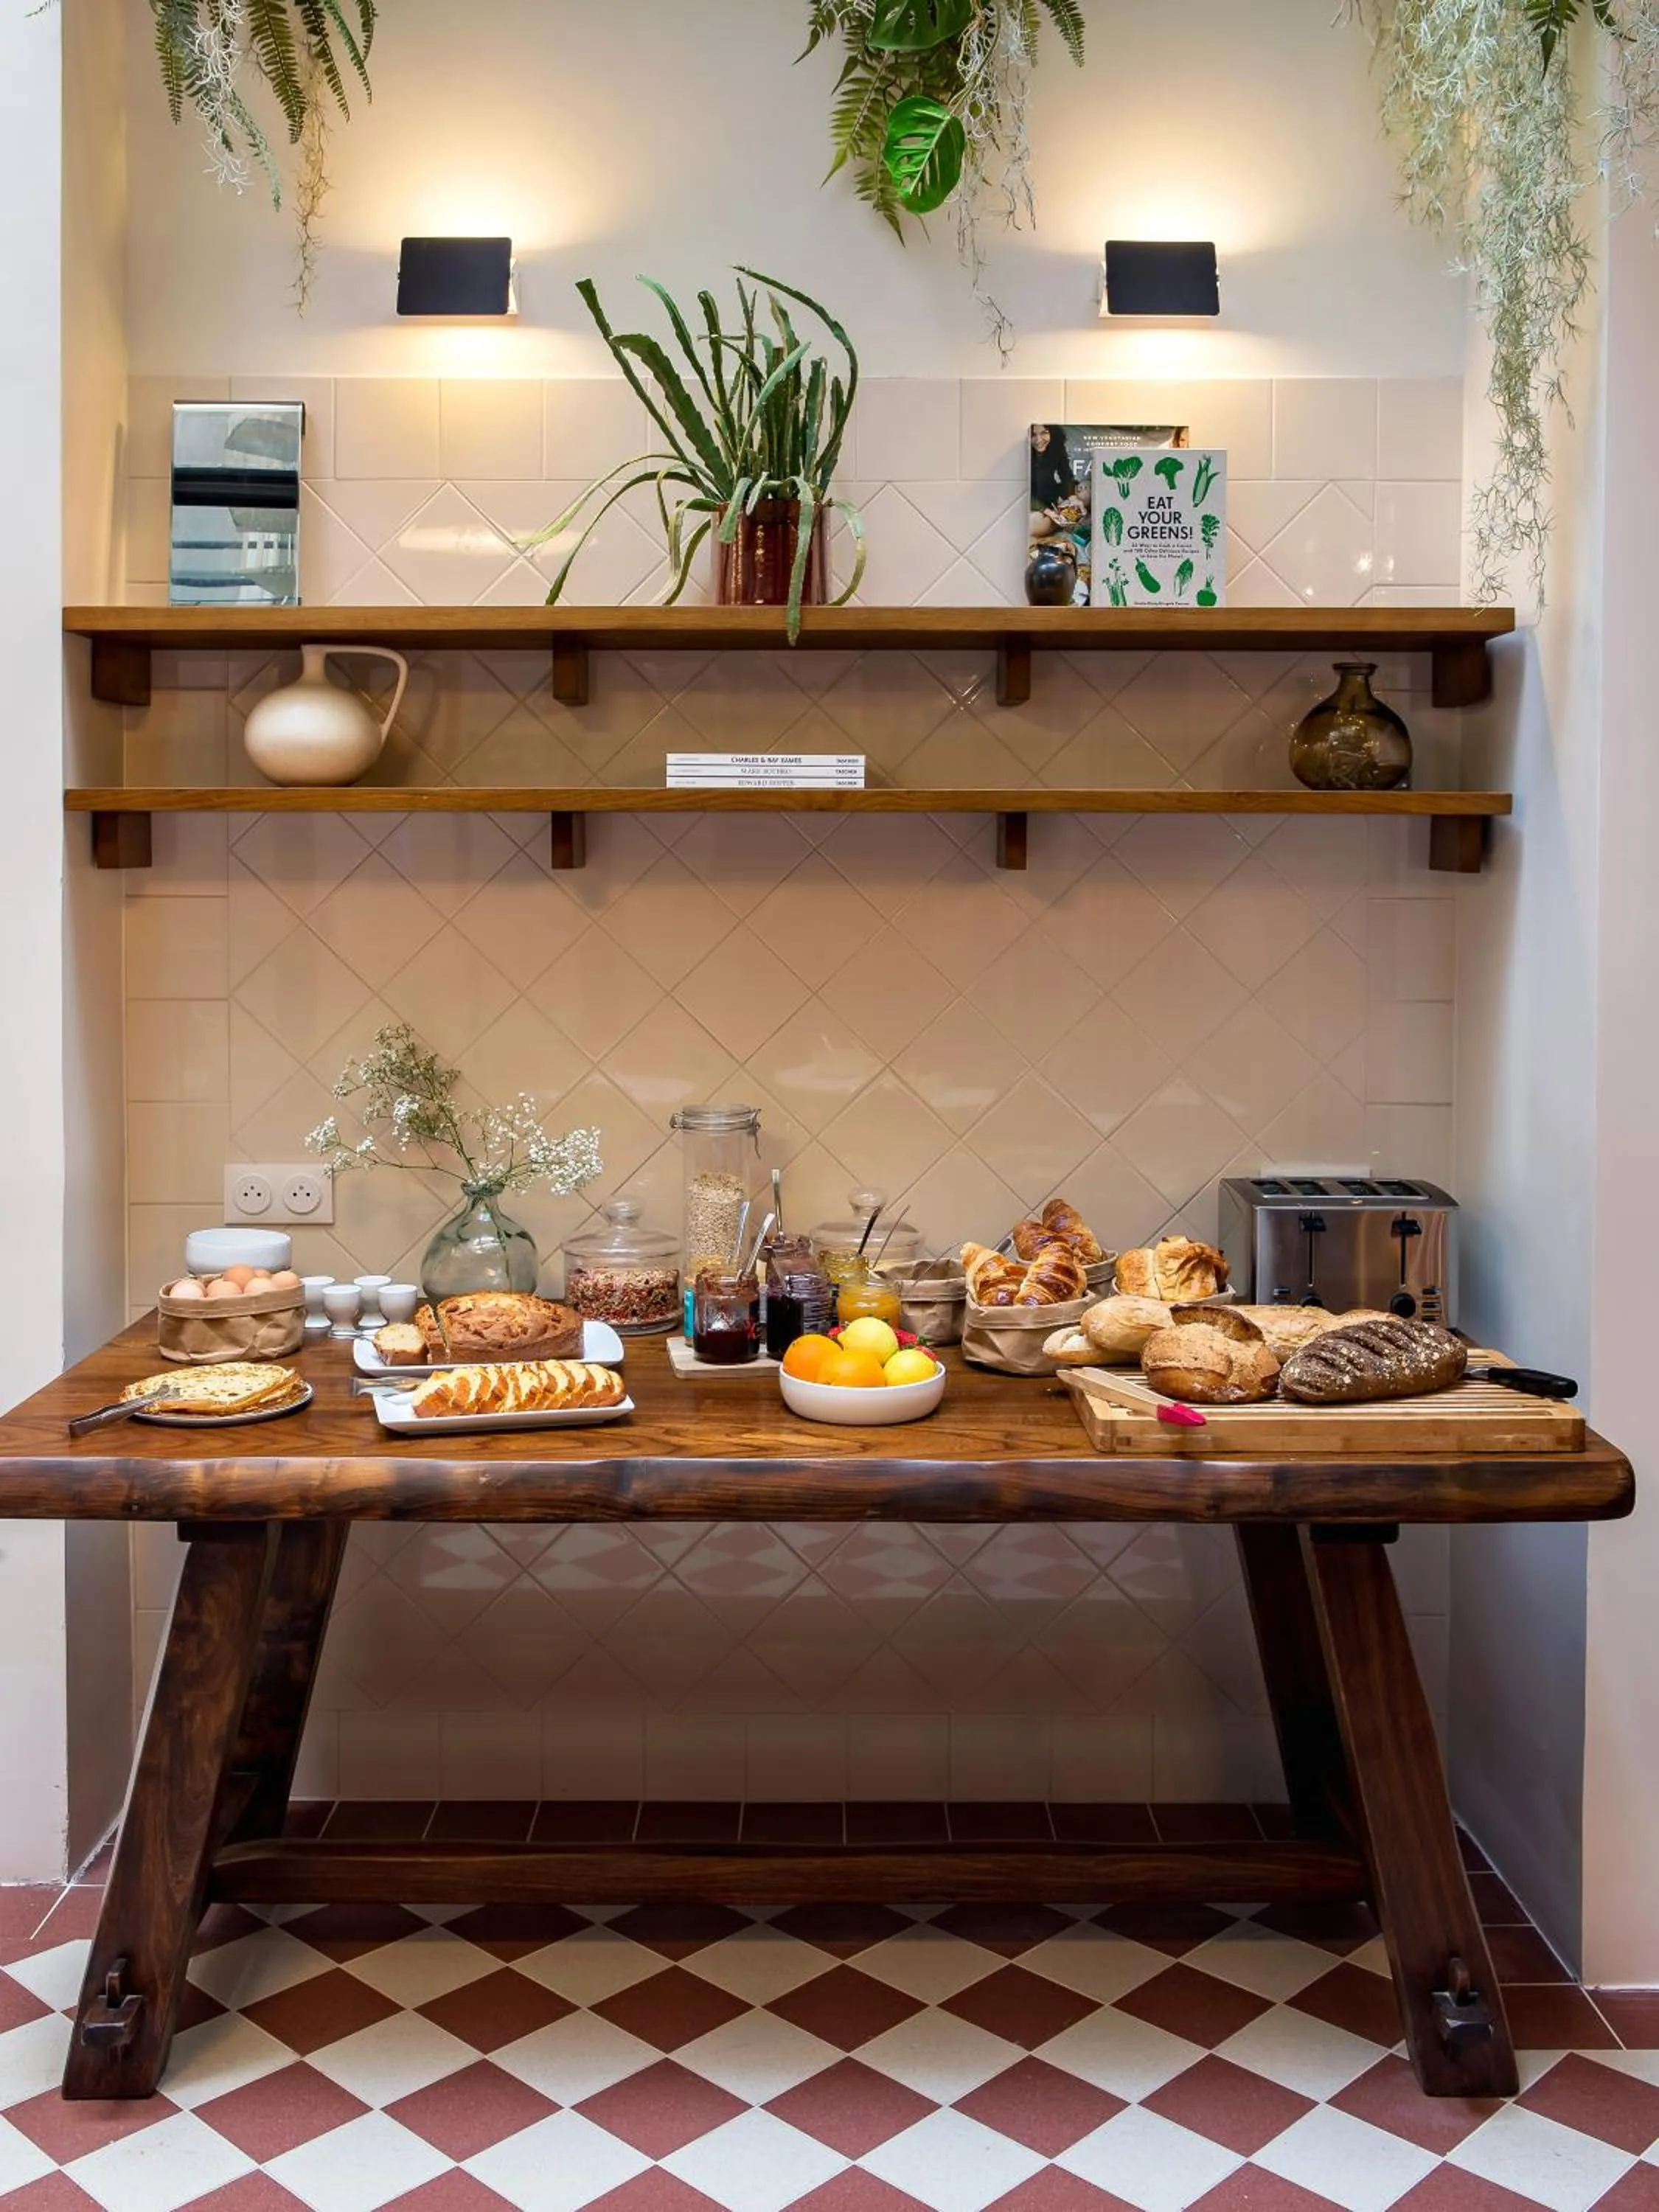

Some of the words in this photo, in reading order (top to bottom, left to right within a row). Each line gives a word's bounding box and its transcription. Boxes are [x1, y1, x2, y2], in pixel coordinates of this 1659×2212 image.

[1147, 496, 1174, 509] EAT
[1138, 511, 1182, 524] YOUR
[1127, 526, 1193, 540] GREENS!
